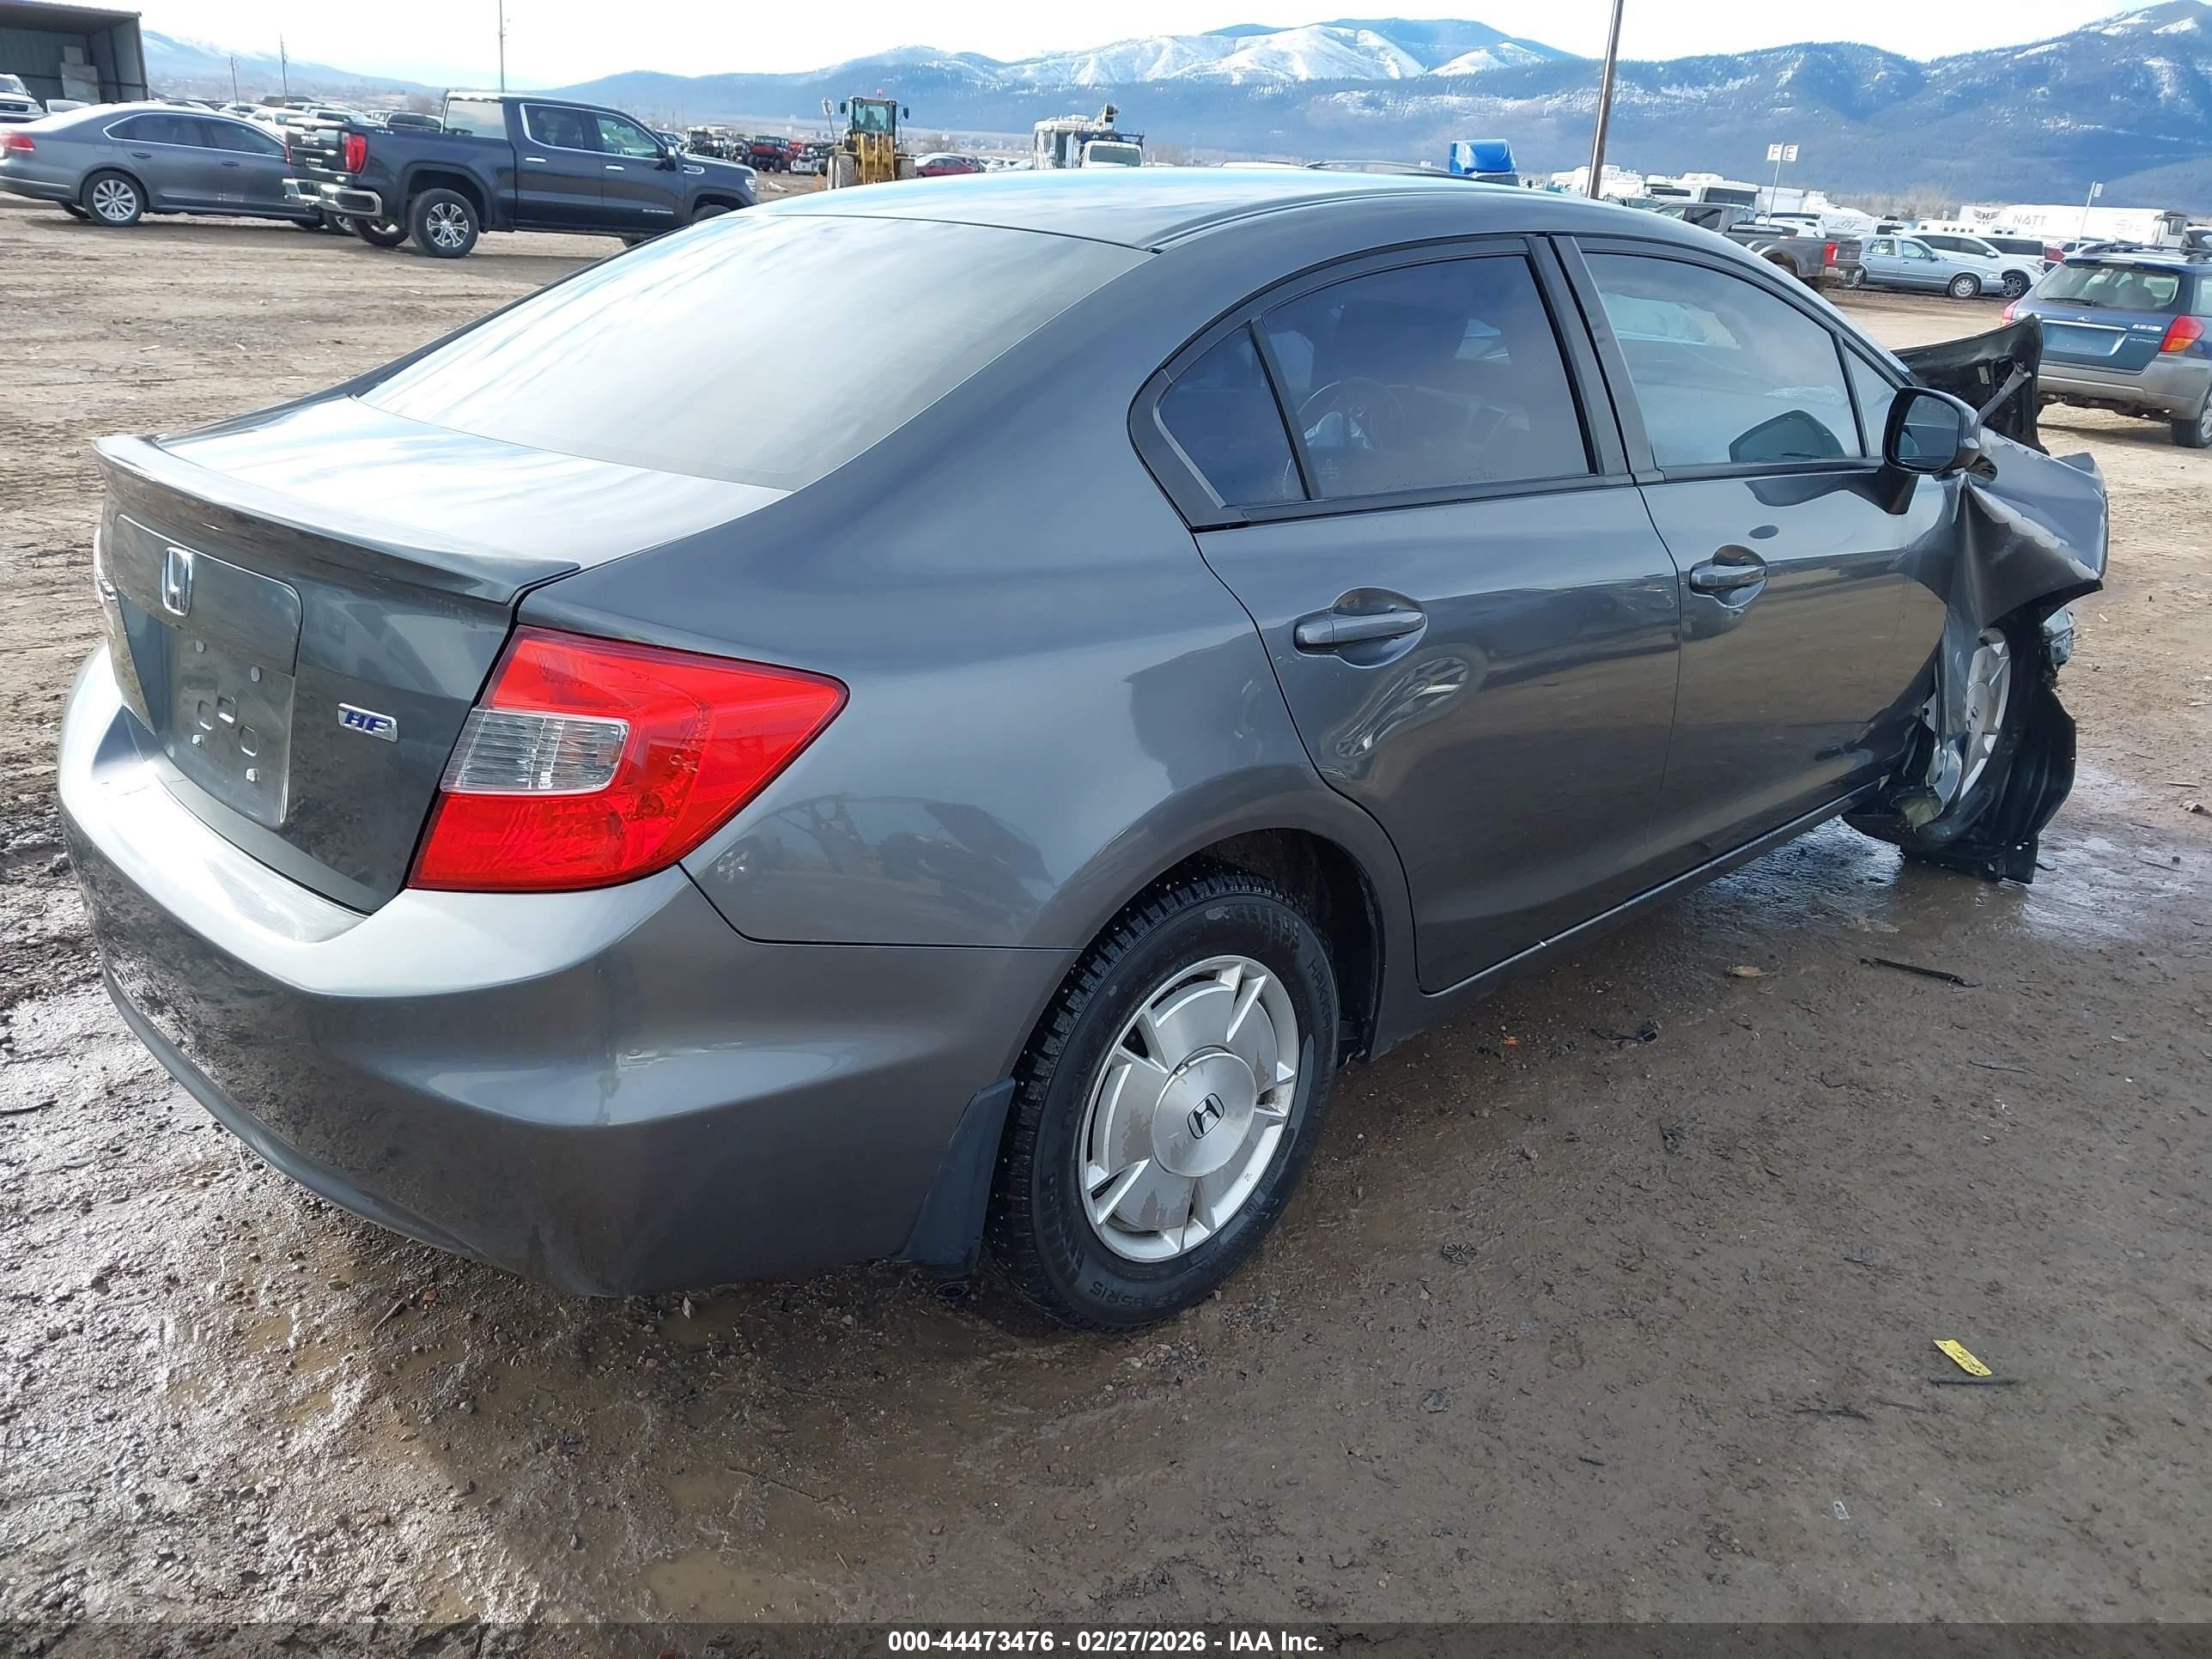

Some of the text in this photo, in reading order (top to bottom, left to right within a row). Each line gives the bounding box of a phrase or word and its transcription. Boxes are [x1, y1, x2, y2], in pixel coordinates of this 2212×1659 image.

[1771, 146, 1779, 158] F
[1786, 147, 1794, 159] E
[2013, 214, 2047, 227] NATT
[343, 710, 390, 734] HF
